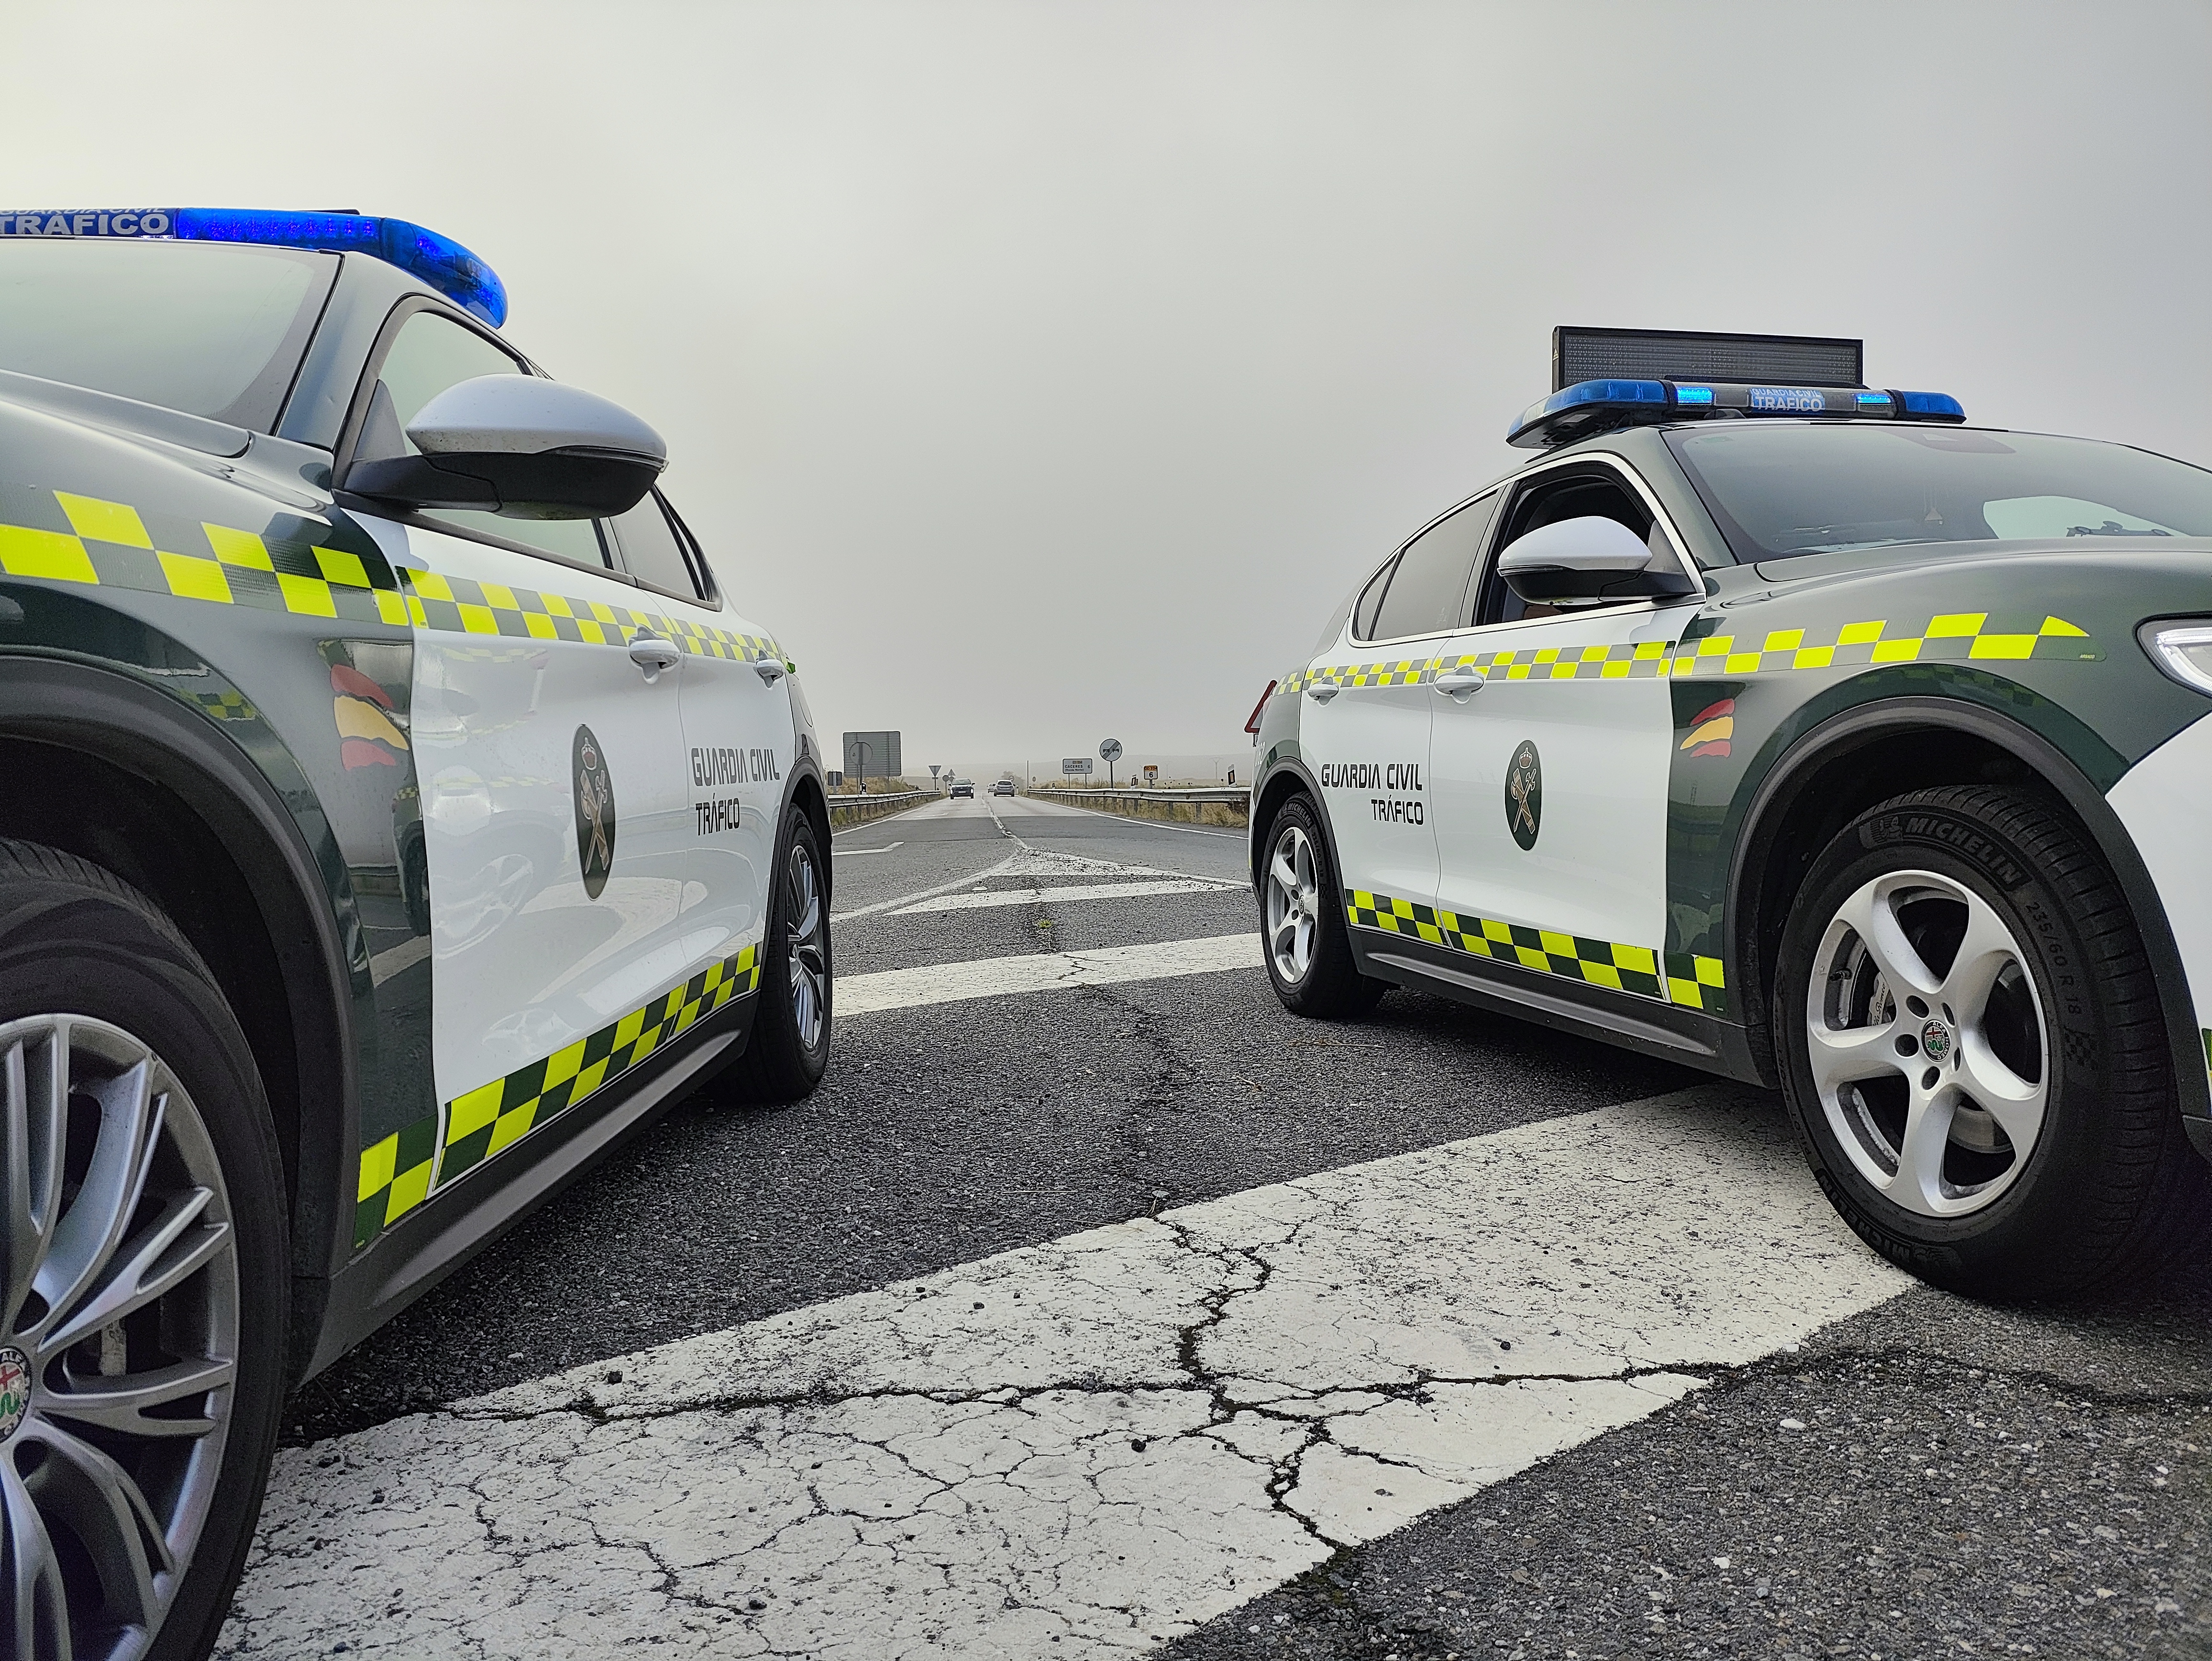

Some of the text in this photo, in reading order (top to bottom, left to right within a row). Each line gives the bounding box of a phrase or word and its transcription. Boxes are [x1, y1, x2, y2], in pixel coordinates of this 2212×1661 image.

[1752, 388, 1795, 396] GUARDIA
[691, 748, 780, 786] GUARDIA CIVIL
[1321, 764, 1422, 791] GUARDIA CIVIL
[696, 793, 740, 836] TRÁFICO
[1287, 803, 1313, 827] MICHELIN
[1371, 794, 1424, 825] TRÁFICO
[1904, 817, 2020, 886] MICHELIN
[2026, 901, 2082, 1015] 235/60 R 18
[1876, 983, 1886, 1015] Romeo
[1933, 1021, 1949, 1060] ALFA ROMEO
[1819, 1173, 1910, 1262] MICHELIN
